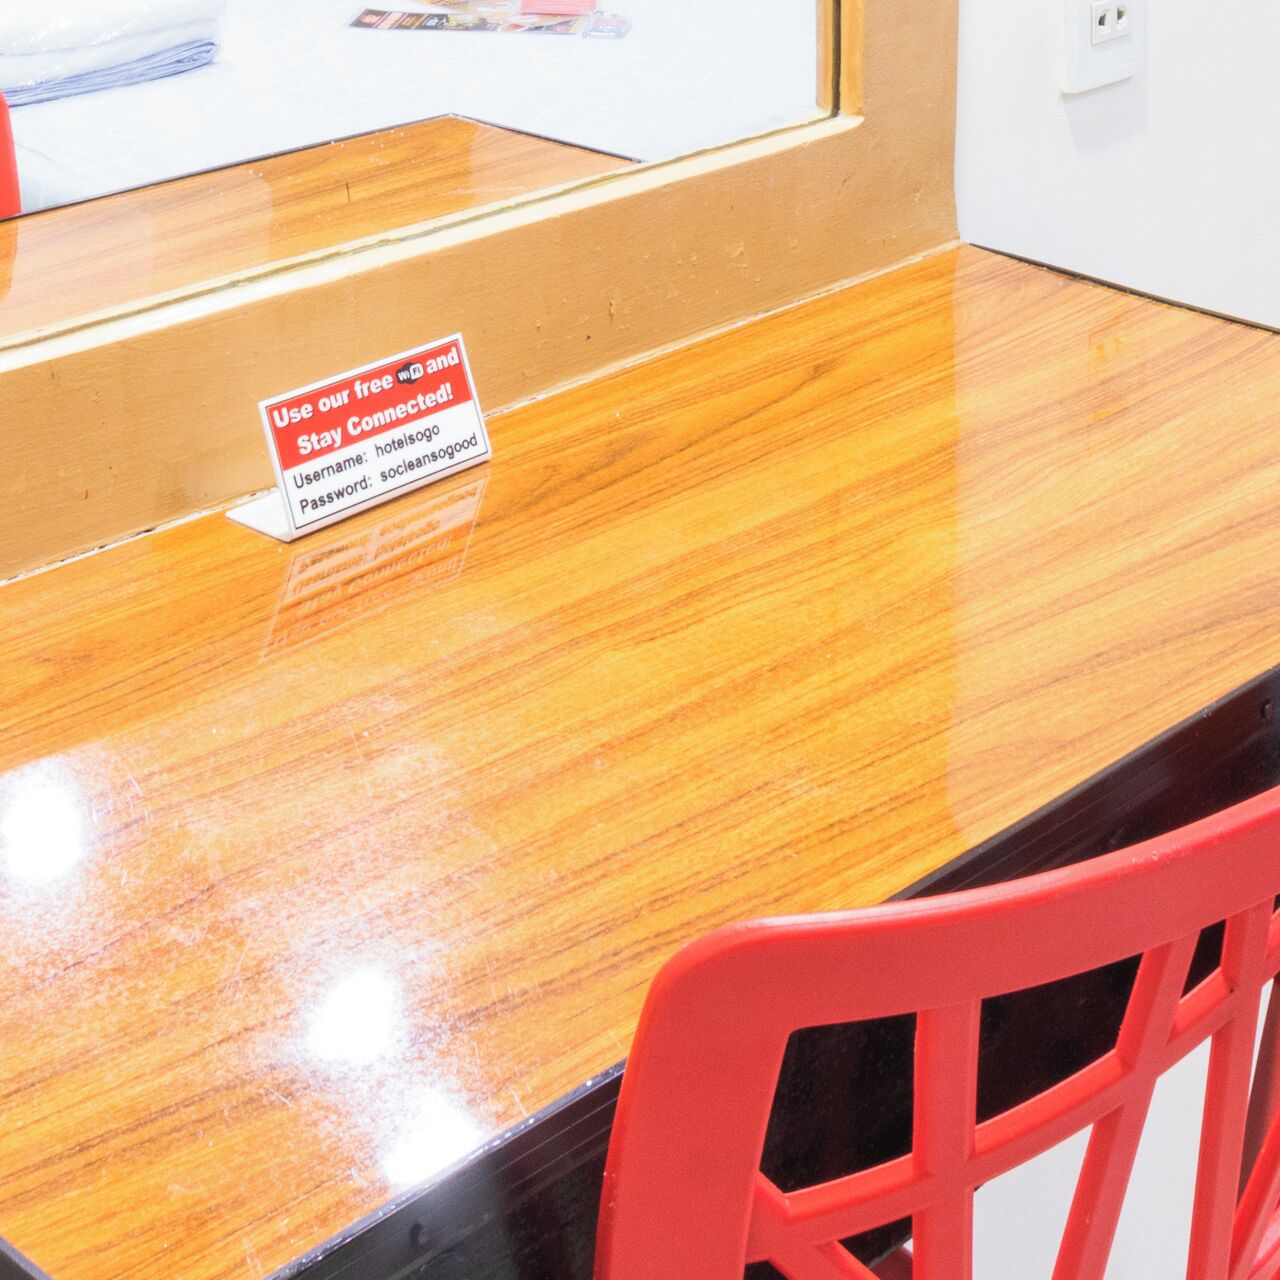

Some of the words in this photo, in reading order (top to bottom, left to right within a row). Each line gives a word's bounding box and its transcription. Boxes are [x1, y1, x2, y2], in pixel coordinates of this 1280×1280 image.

[273, 403, 314, 429] Use
[318, 388, 350, 413] our
[354, 373, 394, 400] free
[425, 347, 460, 374] and
[297, 427, 343, 456] Stay
[346, 382, 454, 437] Connected!
[293, 450, 369, 490] Username:
[374, 423, 441, 459] hotelsogo
[299, 476, 374, 514] Password:
[379, 433, 479, 483] socleansogood
